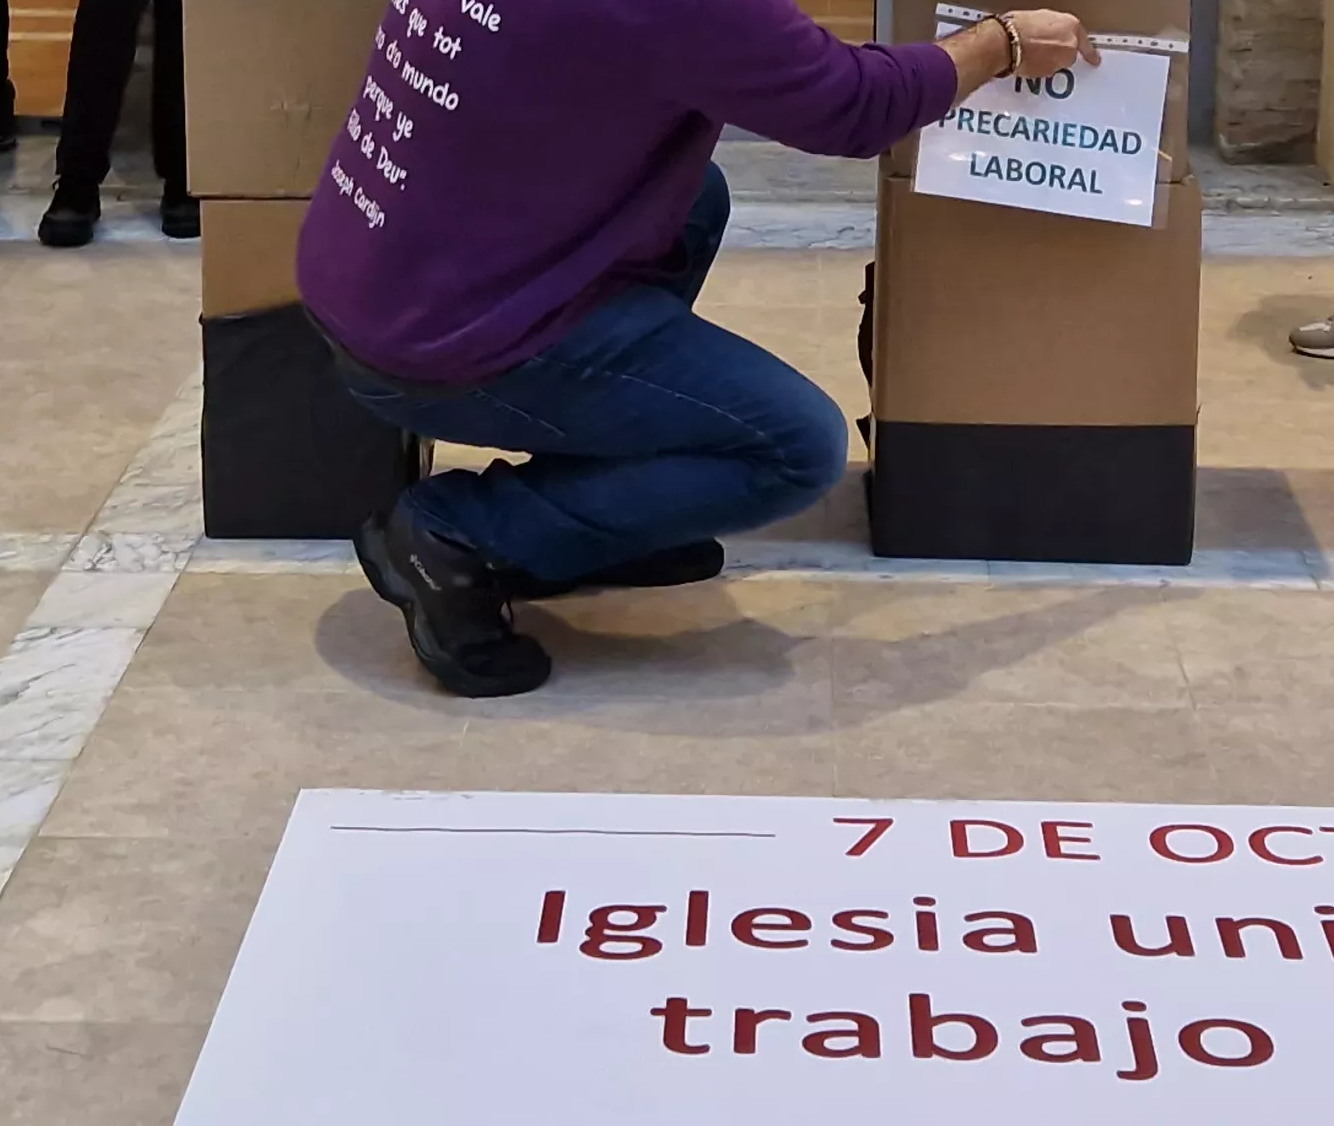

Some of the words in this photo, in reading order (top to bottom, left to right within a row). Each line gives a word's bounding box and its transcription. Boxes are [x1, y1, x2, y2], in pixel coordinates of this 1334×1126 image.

[407, 8, 427, 37] que
[433, 26, 462, 60] tot
[401, 61, 459, 110] mundo
[1014, 68, 1075, 100] NO
[361, 132, 375, 159] de
[393, 111, 413, 141] ye
[938, 107, 1143, 155] PRECARIEDAD
[969, 153, 1103, 194] LABORAL
[832, 817, 895, 858] 7
[949, 819, 1101, 861] DE
[535, 889, 1038, 961] Iglesia
[649, 992, 1276, 1082] trabajo
